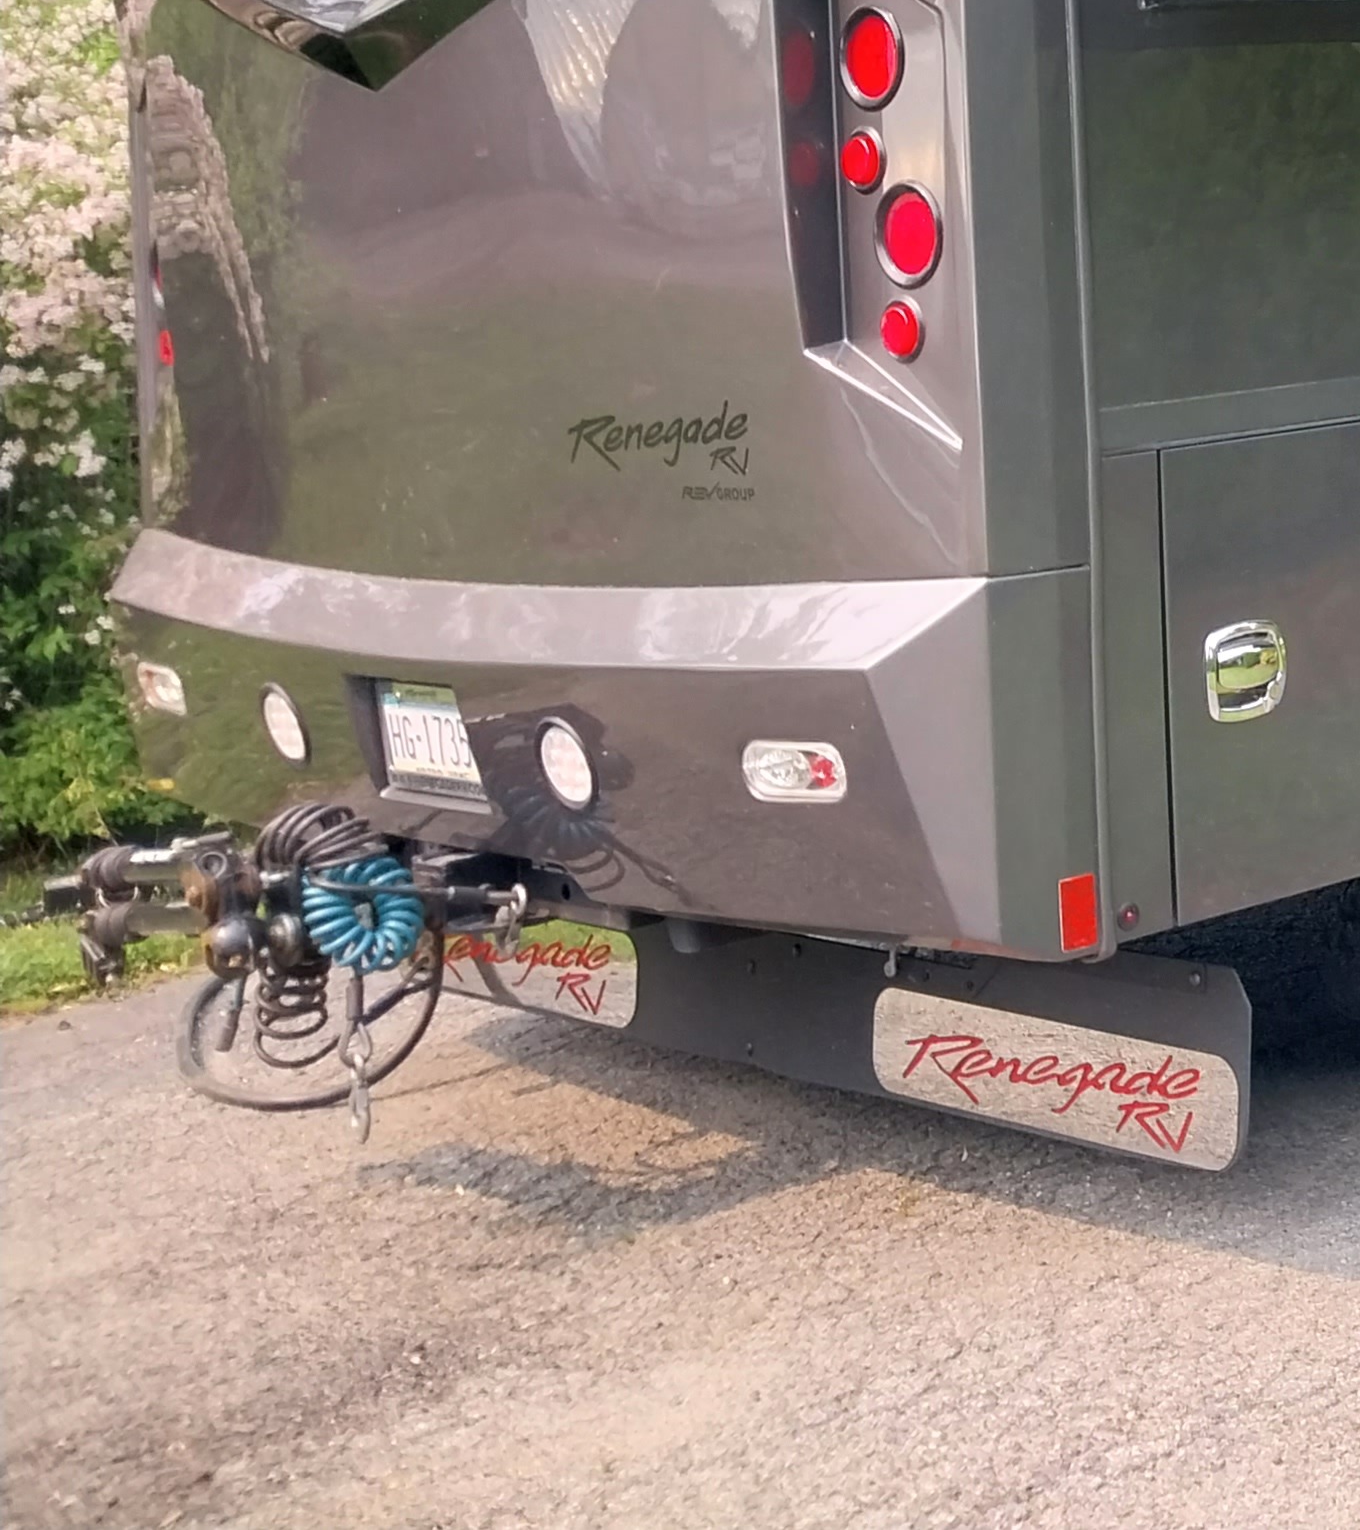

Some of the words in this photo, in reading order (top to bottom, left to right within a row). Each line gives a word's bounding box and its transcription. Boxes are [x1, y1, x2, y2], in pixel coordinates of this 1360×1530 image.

[567, 399, 748, 472] Renegade
[709, 445, 749, 476] RV
[716, 487, 756, 502] GROUP
[554, 972, 607, 1015] RV
[902, 1033, 1201, 1114] Renegade
[1115, 1100, 1194, 1152] RV
